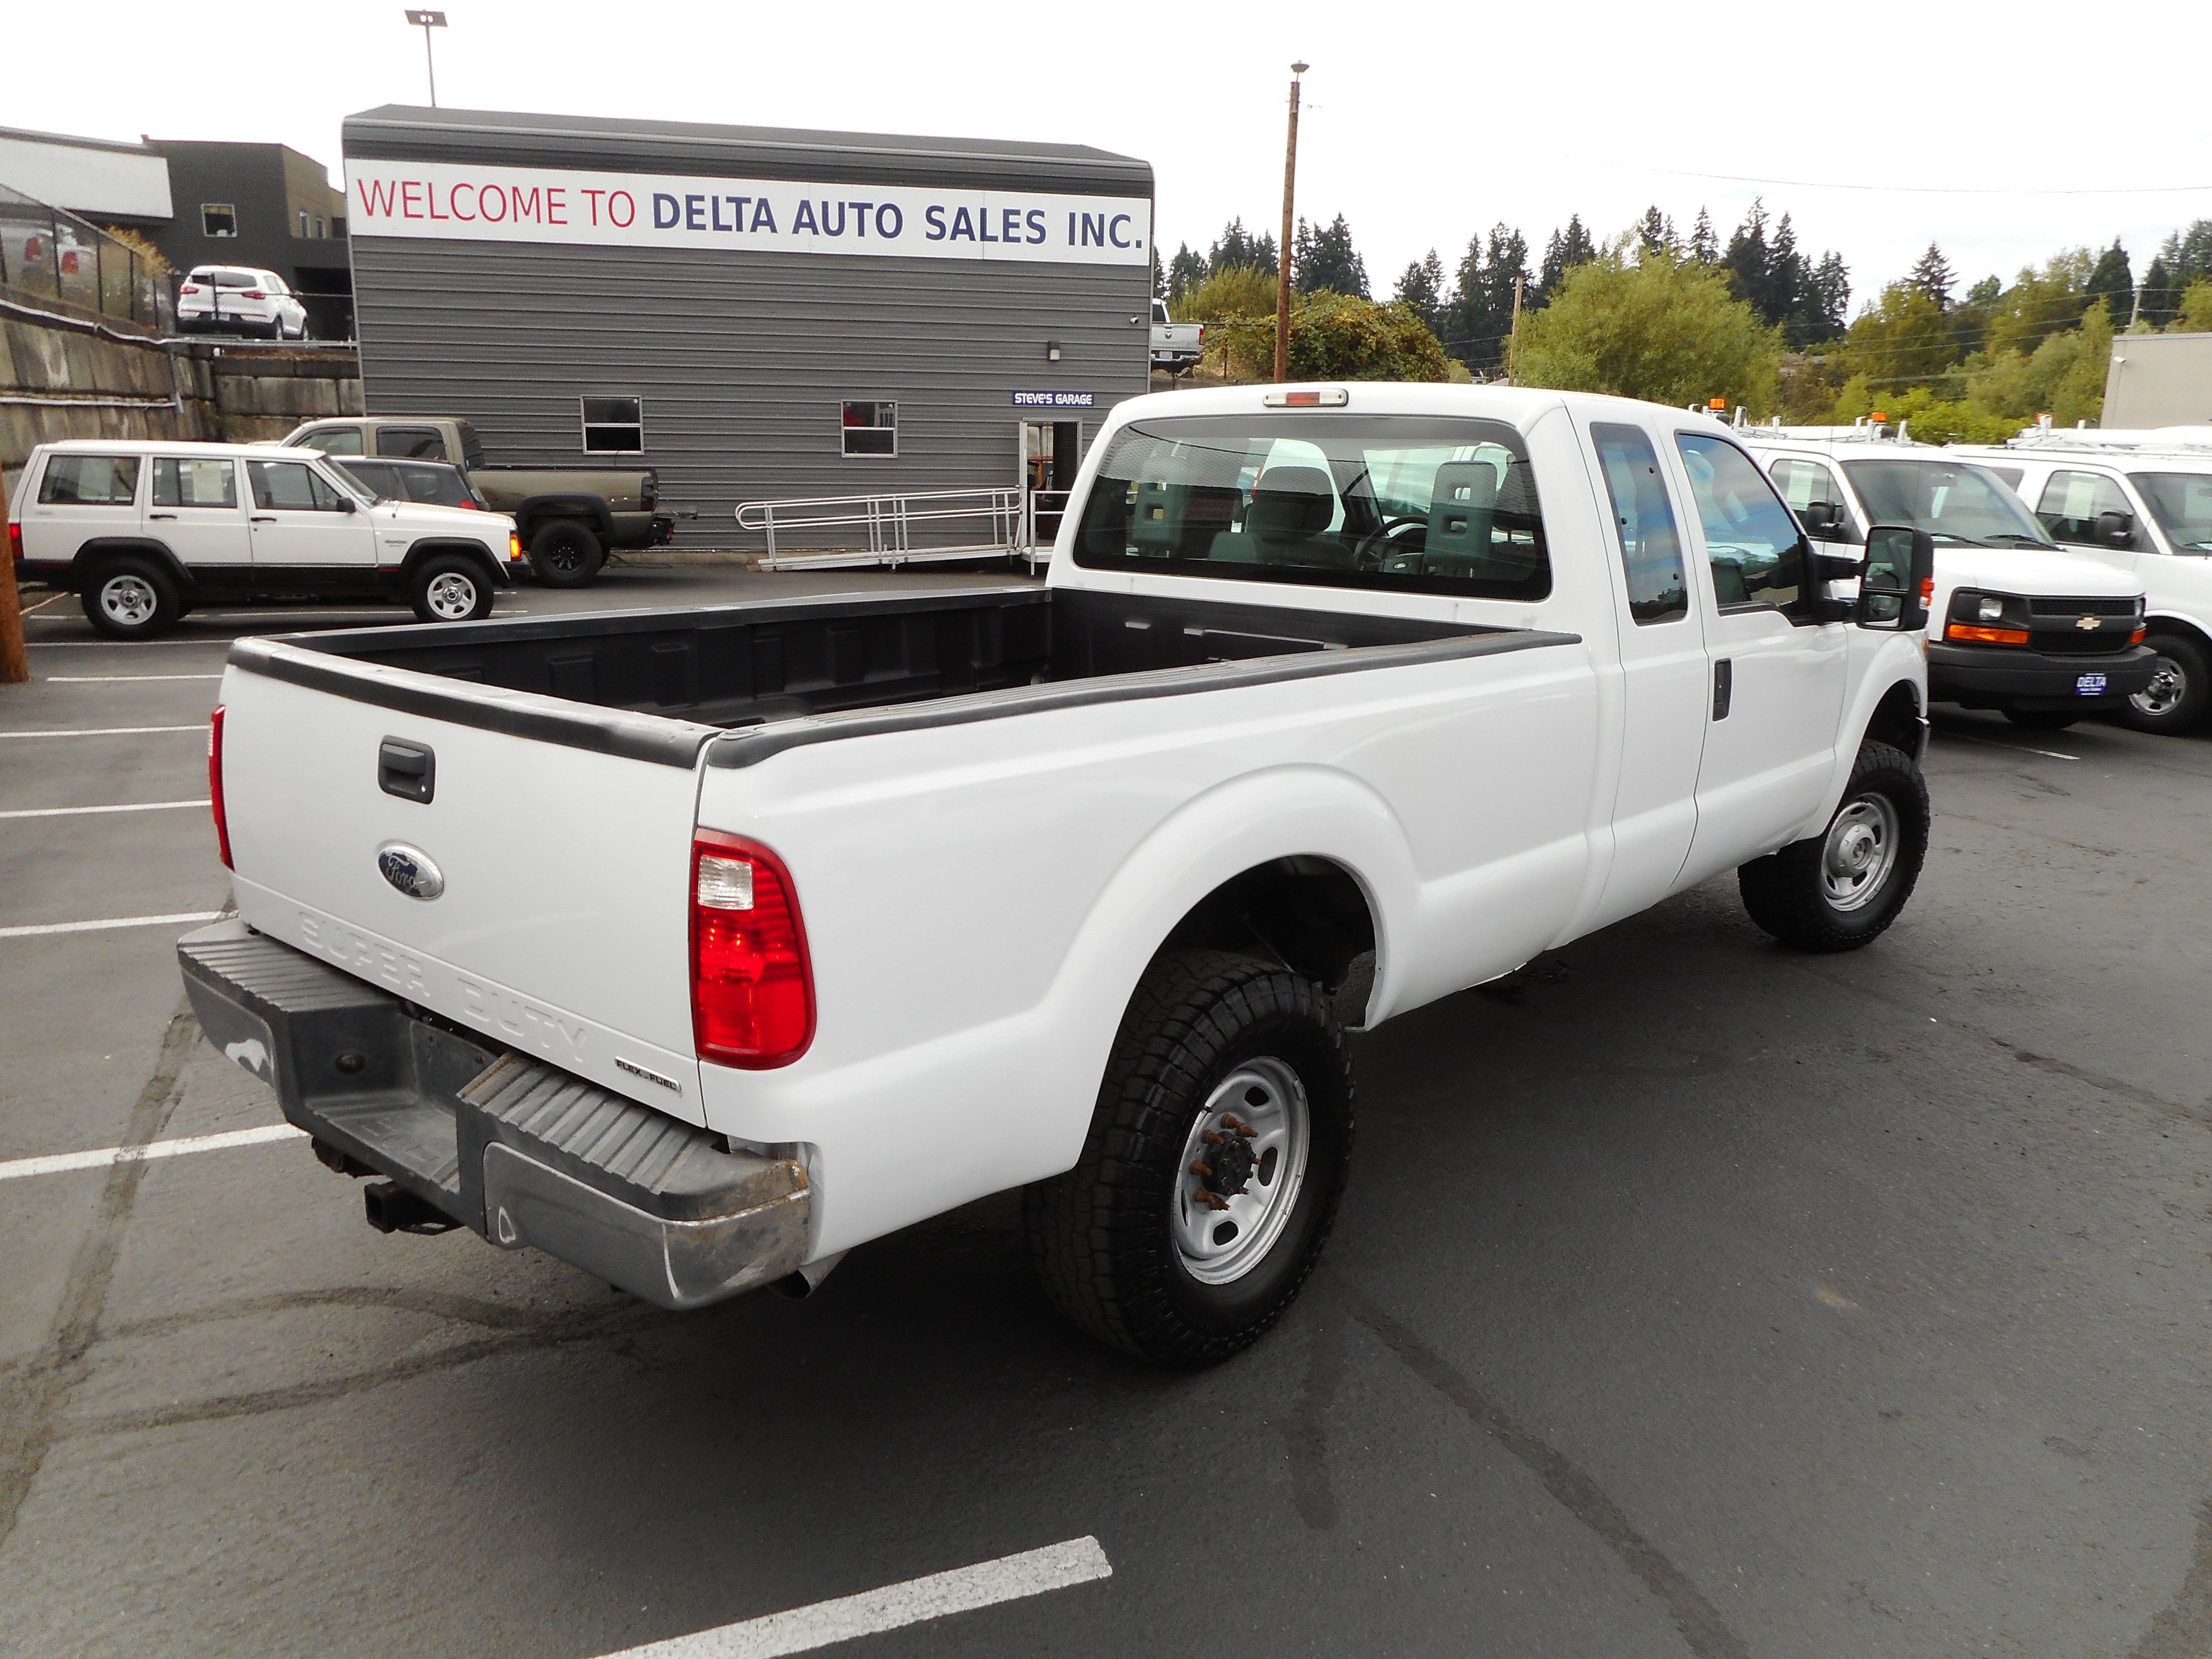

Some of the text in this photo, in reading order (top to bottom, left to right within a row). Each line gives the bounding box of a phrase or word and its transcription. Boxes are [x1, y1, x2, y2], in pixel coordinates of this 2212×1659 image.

[357, 179, 1142, 249] WELCOME TO DELTA AUTO SALES INC.
[1015, 393, 1092, 405] STEVE'S GARAGE
[2076, 677, 2107, 687] DELTA
[299, 911, 587, 1063] SUPER DUTY
[616, 1059, 677, 1091] FLEX FUEL
